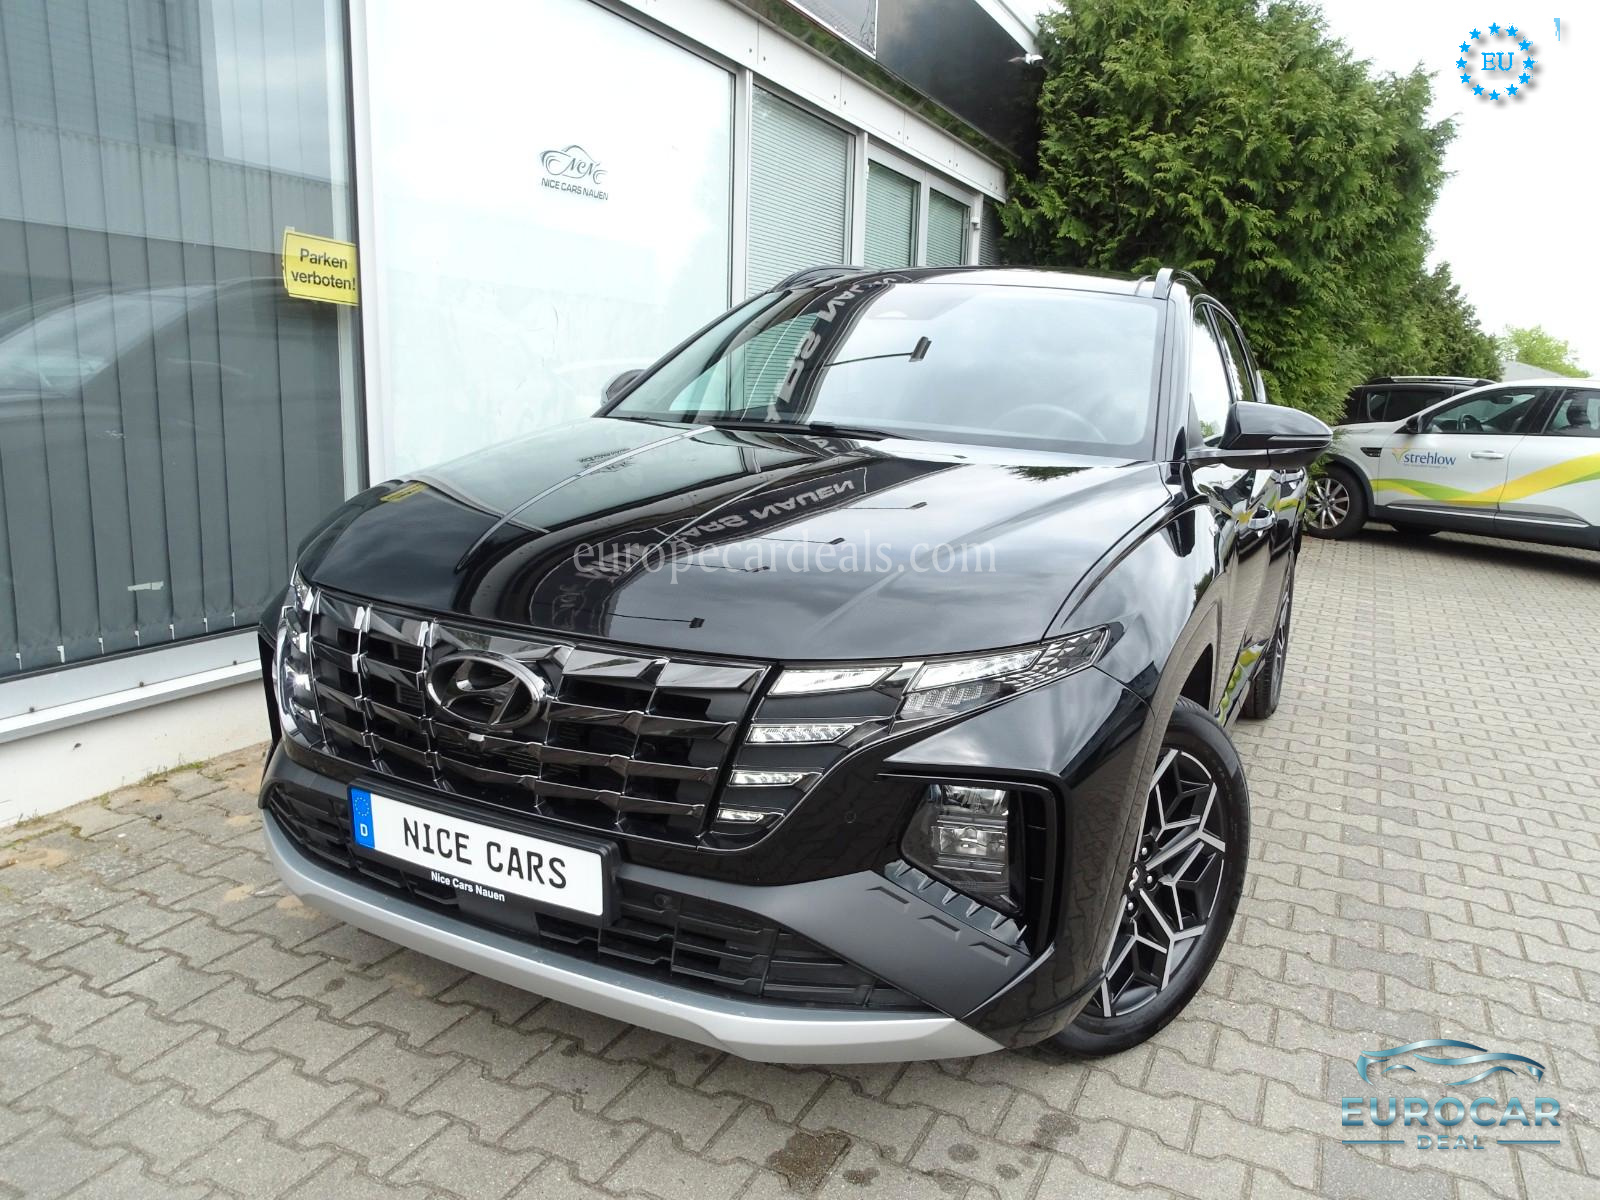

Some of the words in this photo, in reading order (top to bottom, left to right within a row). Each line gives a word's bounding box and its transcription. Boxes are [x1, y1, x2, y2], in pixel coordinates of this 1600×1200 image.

[541, 177, 560, 190] NICE
[561, 182, 582, 195] CARS
[582, 187, 608, 201] NAUEN
[300, 247, 348, 270] Parken
[291, 270, 356, 291] verboten!
[1403, 452, 1456, 465] strehlow
[360, 823, 368, 837] D
[403, 816, 472, 866] NICE
[486, 840, 567, 890] CARS
[431, 870, 450, 886] Nice
[452, 877, 474, 893] Cars
[475, 883, 505, 902] Nauen
